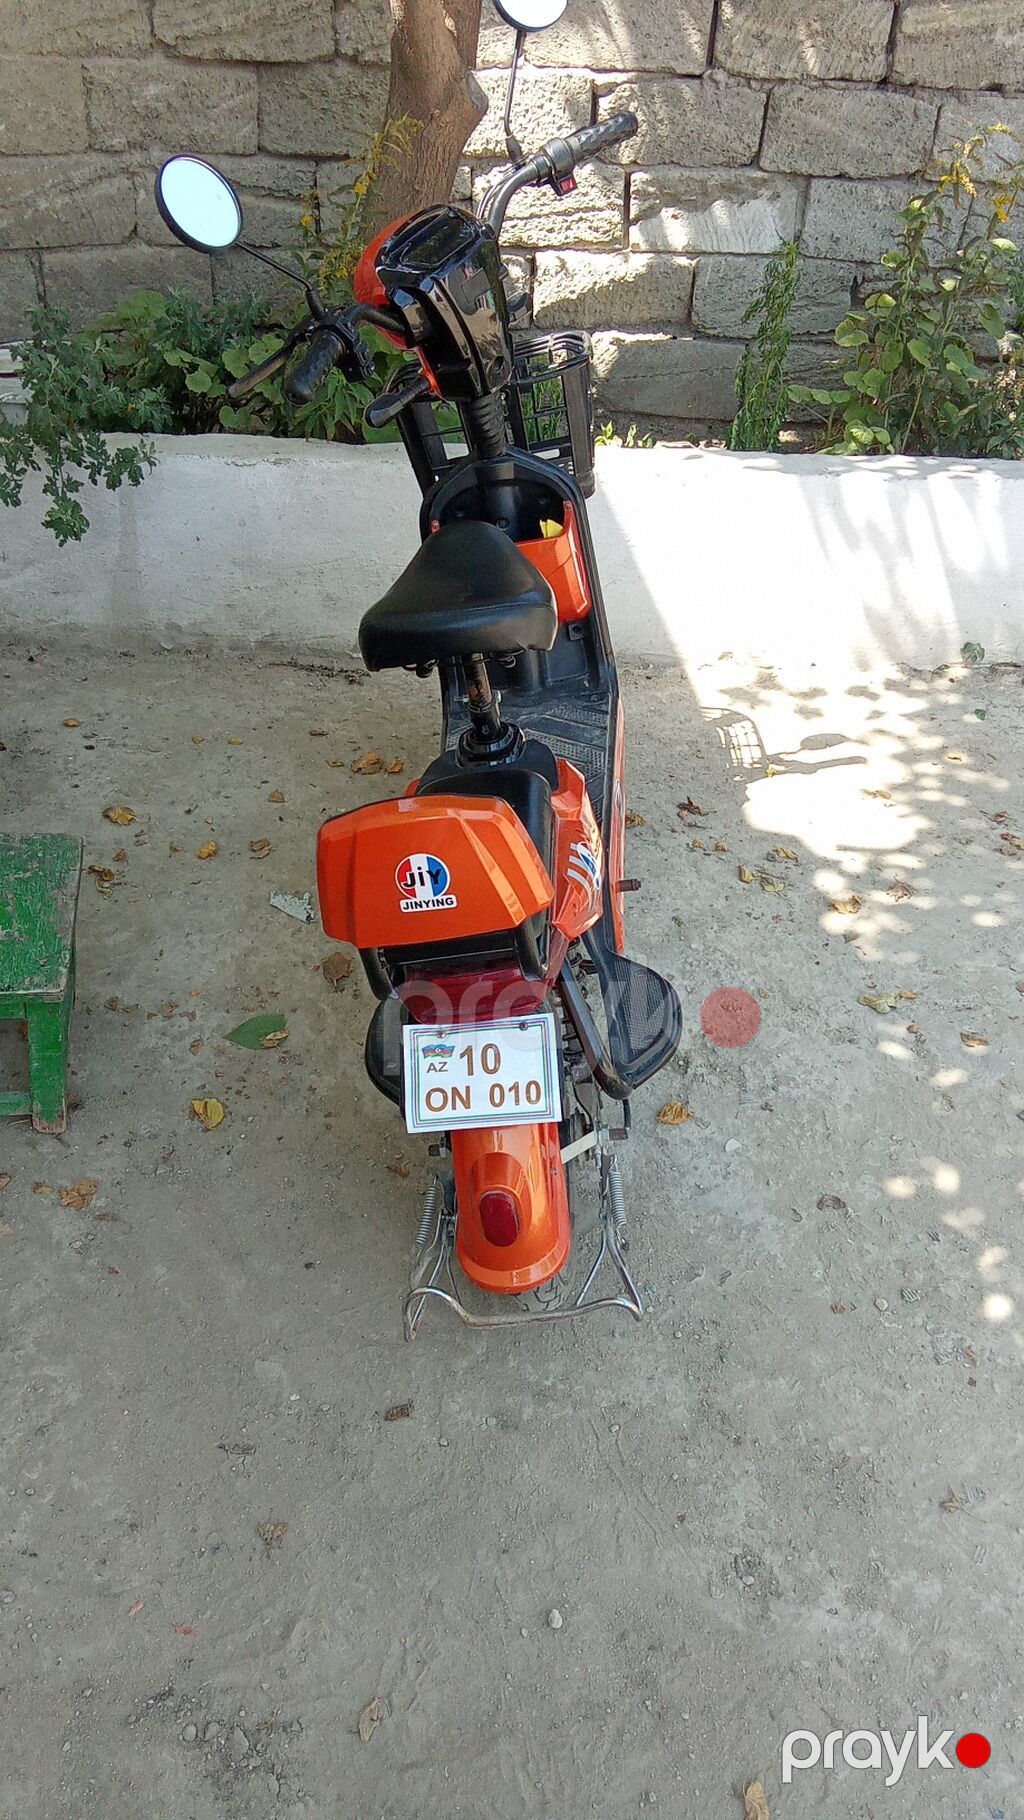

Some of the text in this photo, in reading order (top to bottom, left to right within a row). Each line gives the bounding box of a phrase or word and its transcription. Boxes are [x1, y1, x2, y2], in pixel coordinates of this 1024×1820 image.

[402, 897, 454, 910] JINYING
[426, 1043, 501, 1076] AZ 10
[425, 1080, 541, 1113] ON 010
